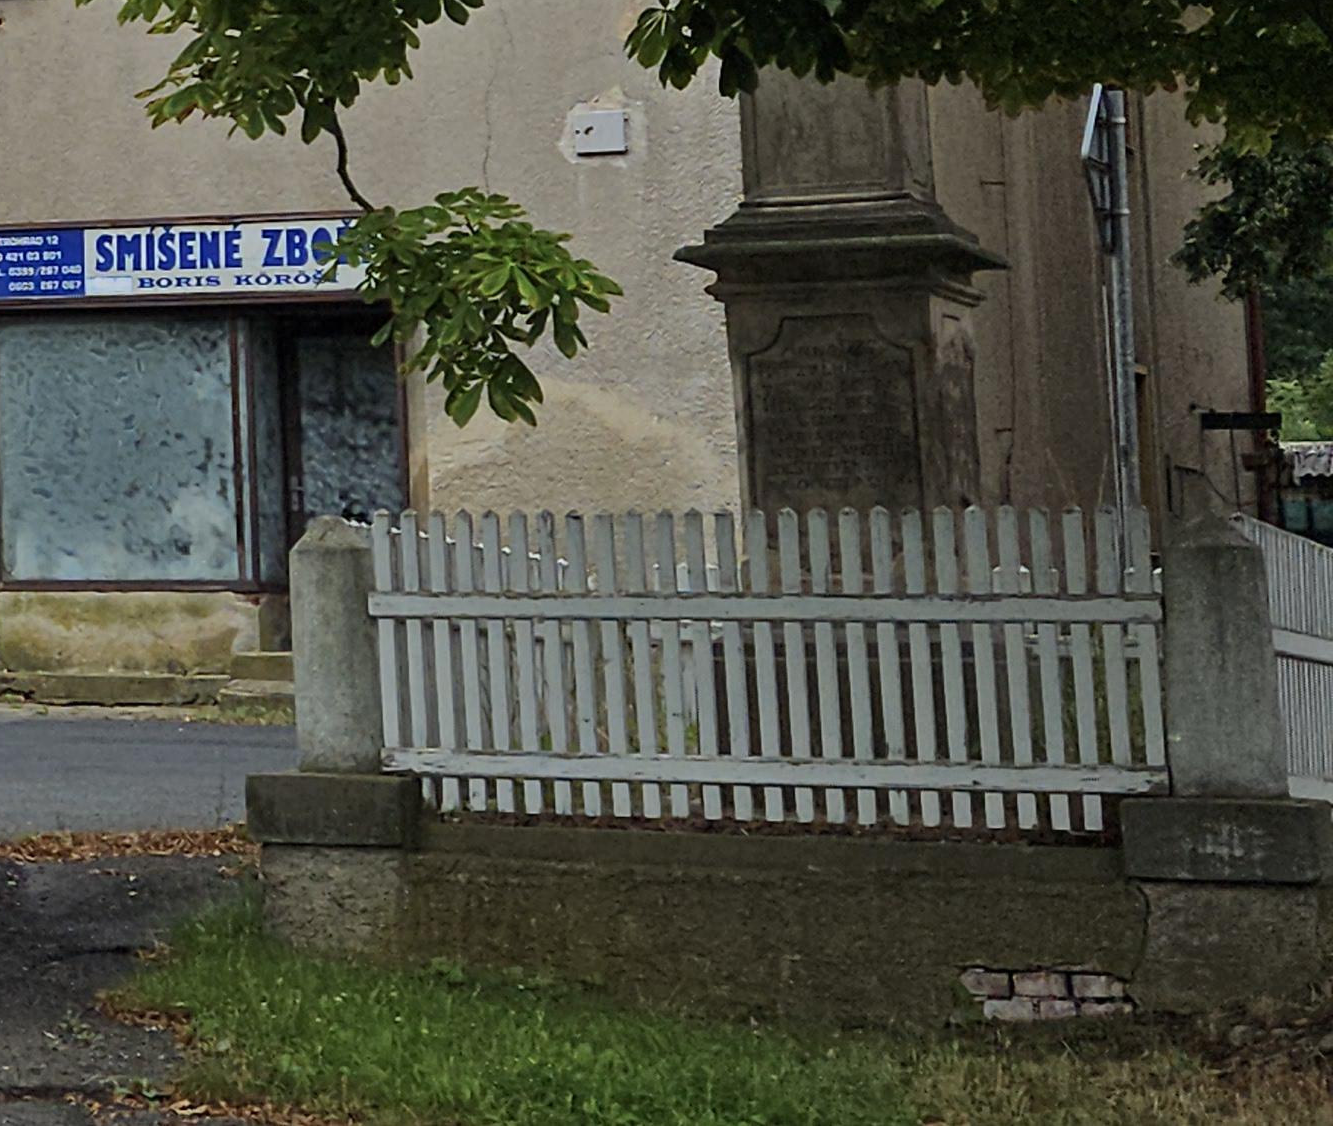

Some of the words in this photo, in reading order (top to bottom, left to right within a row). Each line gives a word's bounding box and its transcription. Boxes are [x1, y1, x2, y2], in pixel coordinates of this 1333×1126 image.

[46, 235, 59, 245] 12
[95, 223, 243, 272] SMÍŠENÉ
[260, 217, 372, 268] ZBOŽ
[137, 276, 221, 289] BORIS
